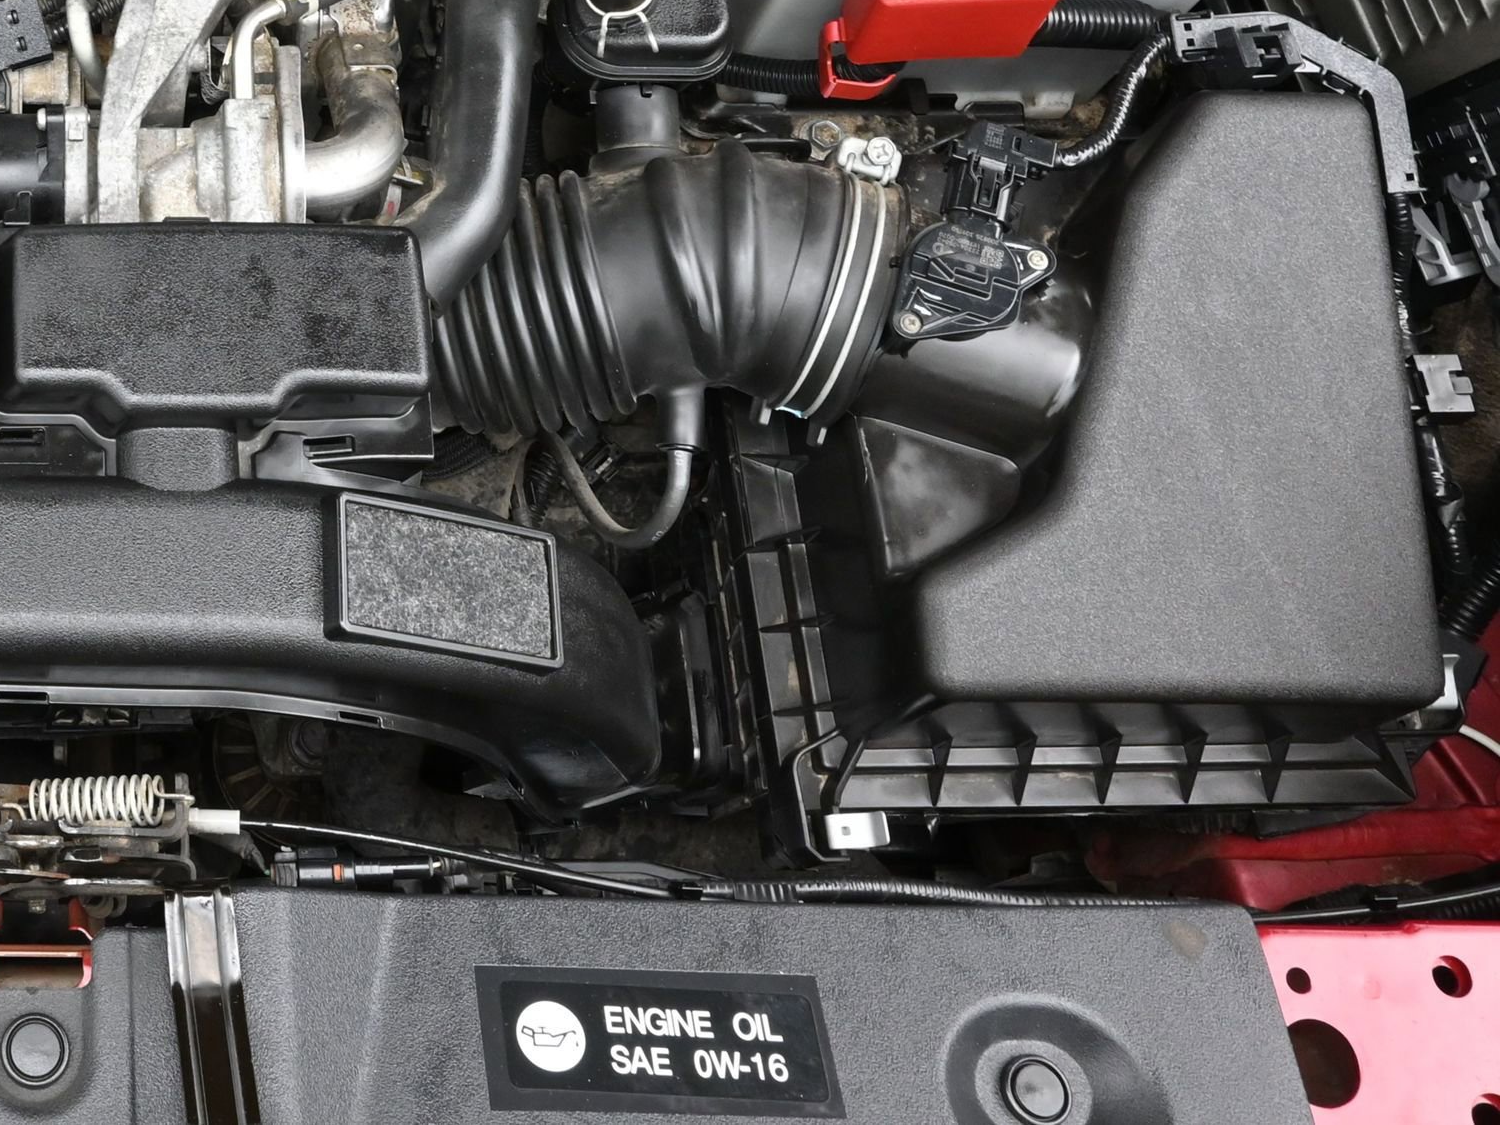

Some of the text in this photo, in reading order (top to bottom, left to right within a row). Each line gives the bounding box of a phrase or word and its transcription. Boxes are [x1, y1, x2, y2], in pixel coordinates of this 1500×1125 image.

[603, 1004, 784, 1043] ENGINE OIL
[610, 1044, 790, 1083] SAE 0W-16
